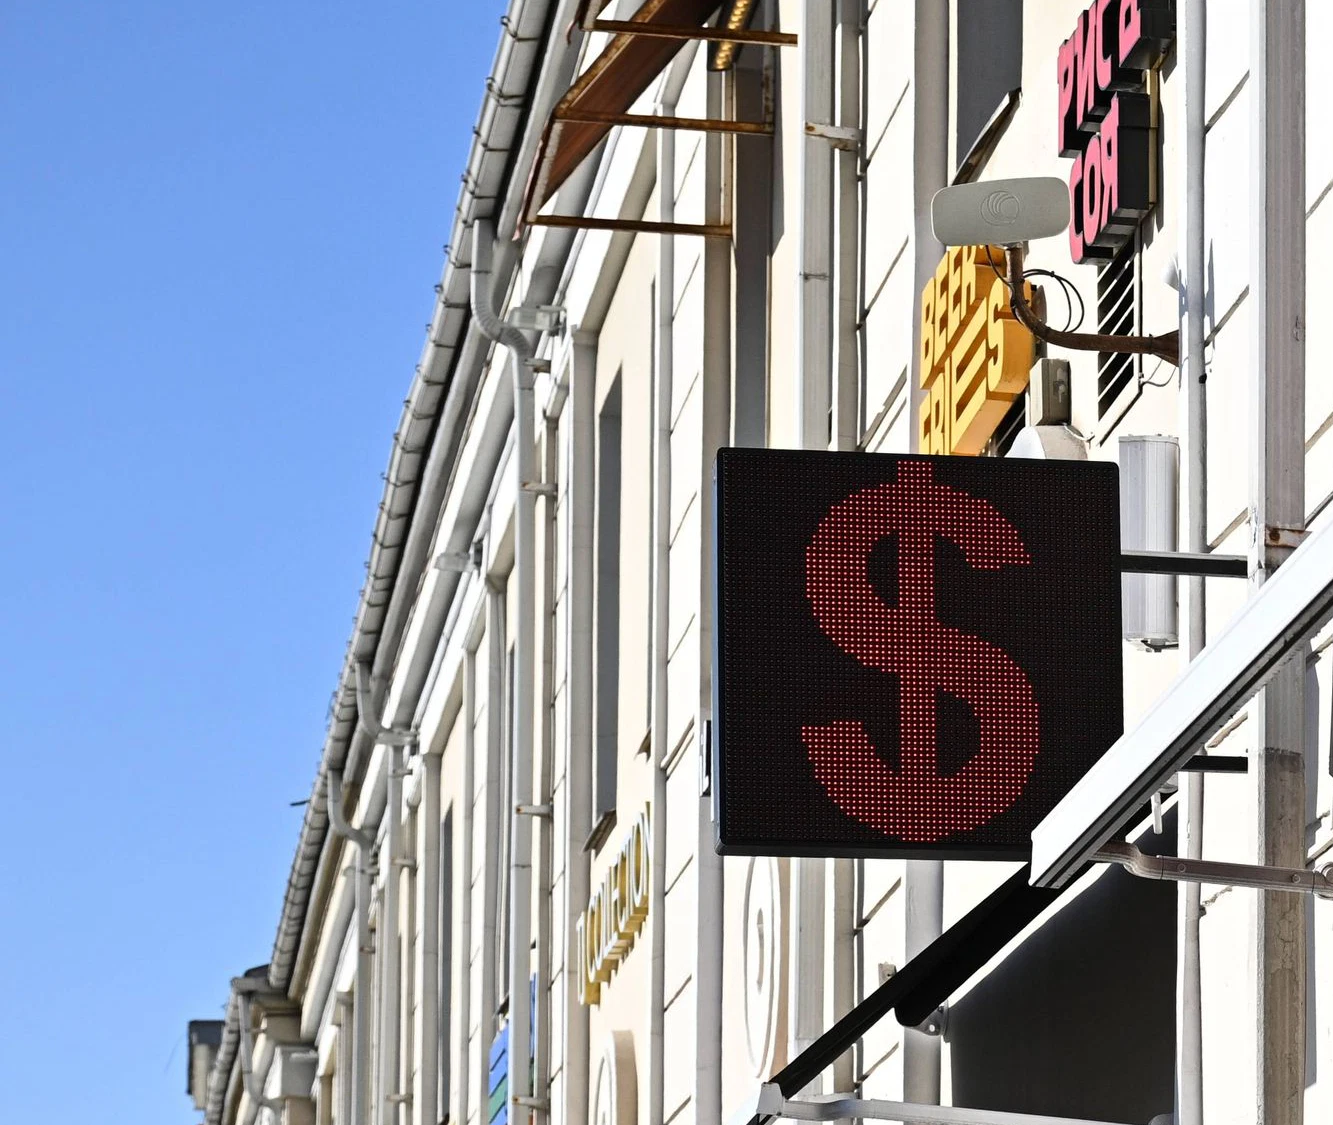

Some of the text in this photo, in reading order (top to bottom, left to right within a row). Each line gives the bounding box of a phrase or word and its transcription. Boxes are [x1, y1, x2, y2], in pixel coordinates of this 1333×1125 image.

[1058, 0, 1112, 157] РИС
[1069, 91, 1119, 264] СОЯ
[920, 246, 977, 389] BEER
[802, 460, 1041, 842] $
